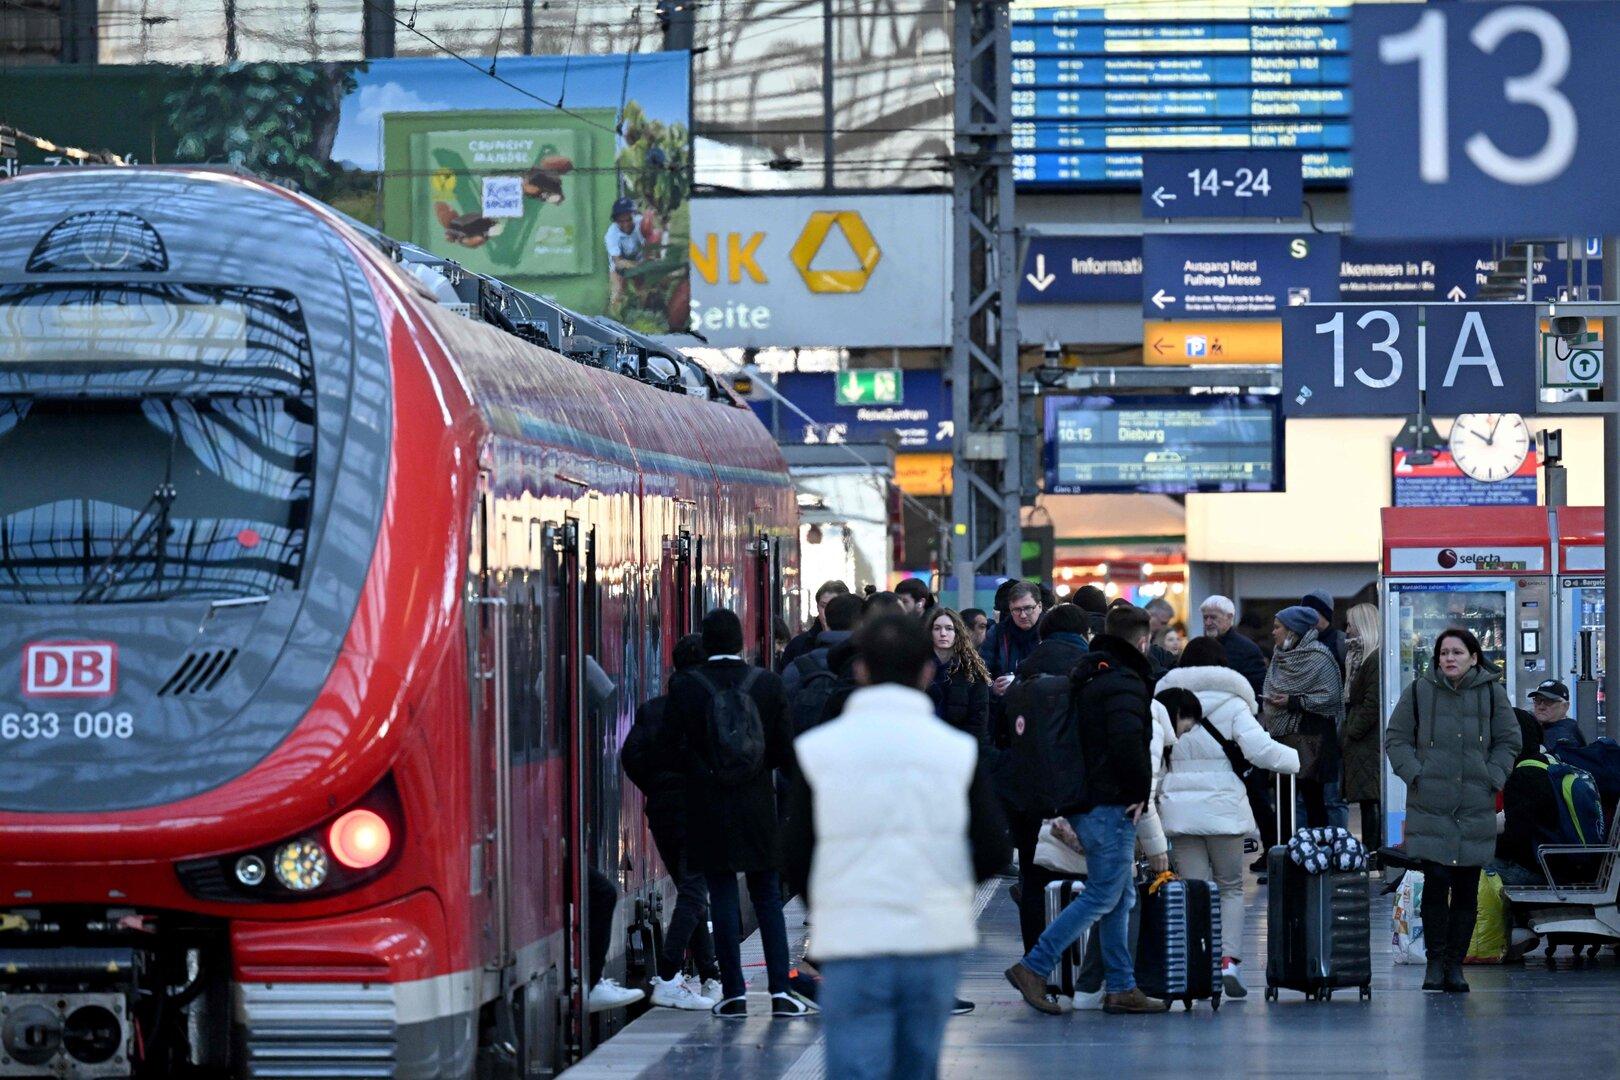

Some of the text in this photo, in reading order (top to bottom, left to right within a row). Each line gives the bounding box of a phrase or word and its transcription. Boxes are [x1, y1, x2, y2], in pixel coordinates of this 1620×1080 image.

[1379, 5, 1578, 185] 13
[1188, 168, 1271, 198] 14-24
[1290, 239, 1307, 258] S
[1183, 259, 1257, 274] Ausgang Nord
[1183, 273, 1262, 288] Fußweg Messe
[1315, 310, 1504, 389] 13 A
[1058, 428, 1165, 443] 10:15 Dieburg
[1459, 553, 1501, 564] selecta
[35, 651, 104, 687] DB
[1, 713, 134, 740] 633 008
